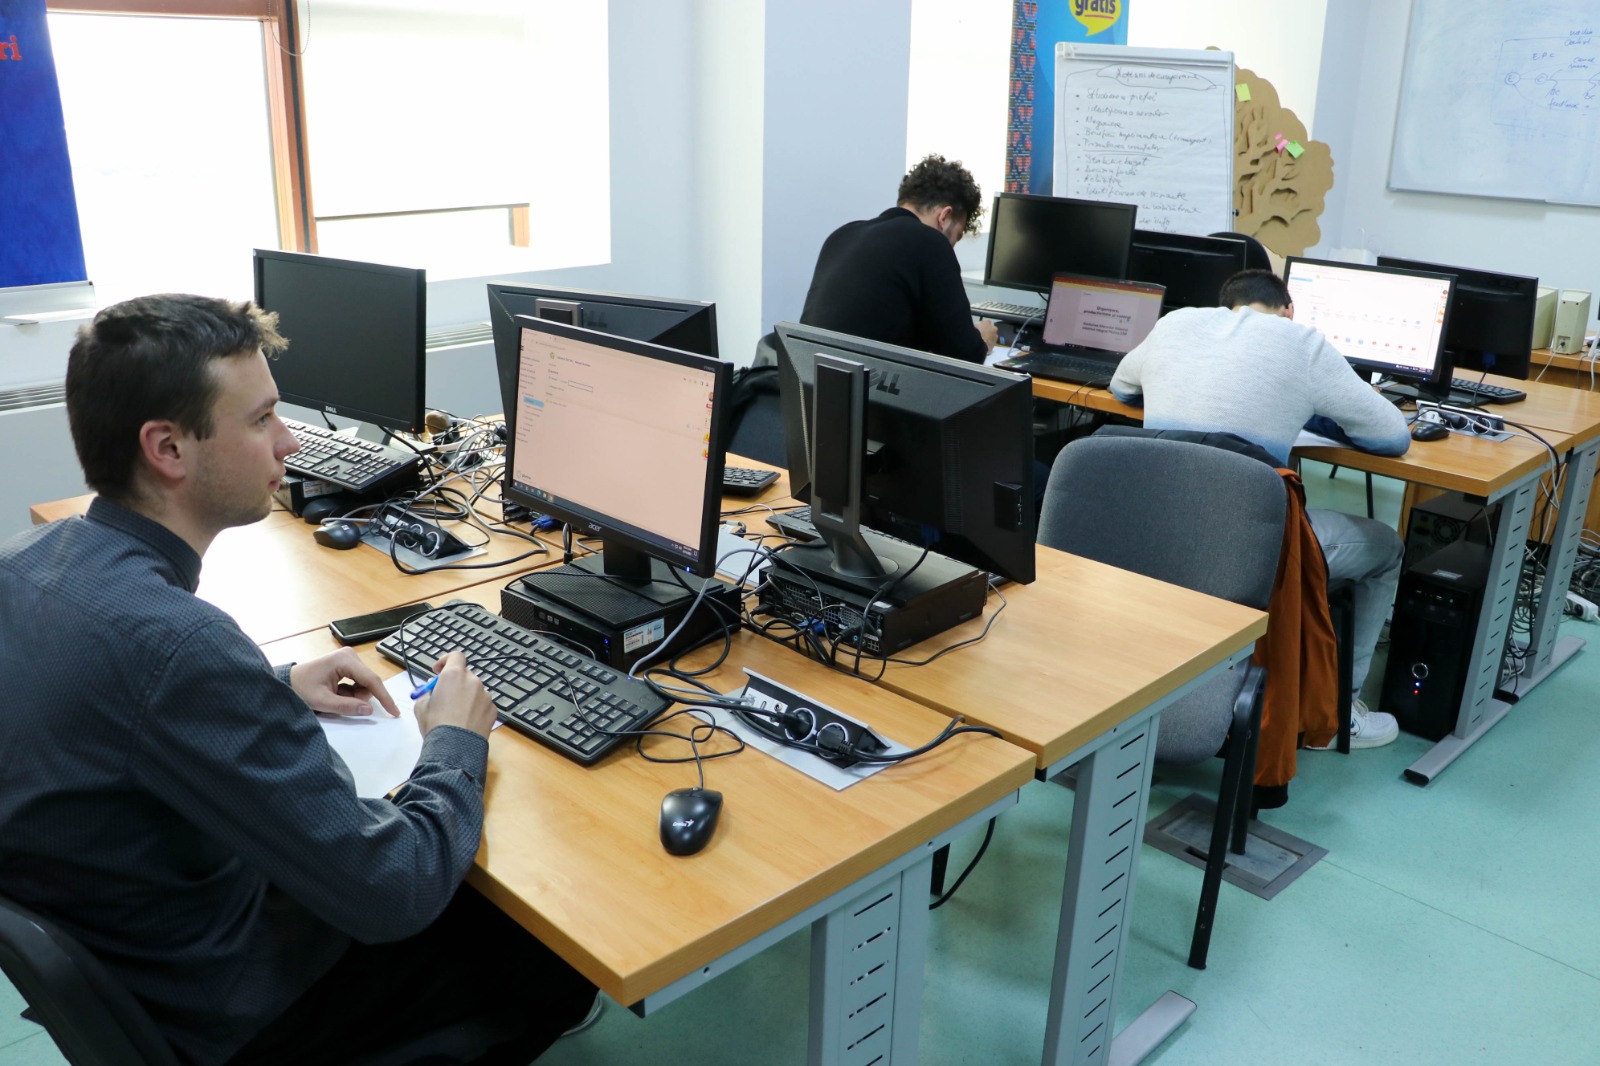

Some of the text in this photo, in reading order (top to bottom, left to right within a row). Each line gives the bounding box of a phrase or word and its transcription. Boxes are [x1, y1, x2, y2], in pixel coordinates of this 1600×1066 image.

[1075, 0, 1116, 16] gratis
[325, 405, 337, 414] DELL
[588, 522, 602, 532] acer
